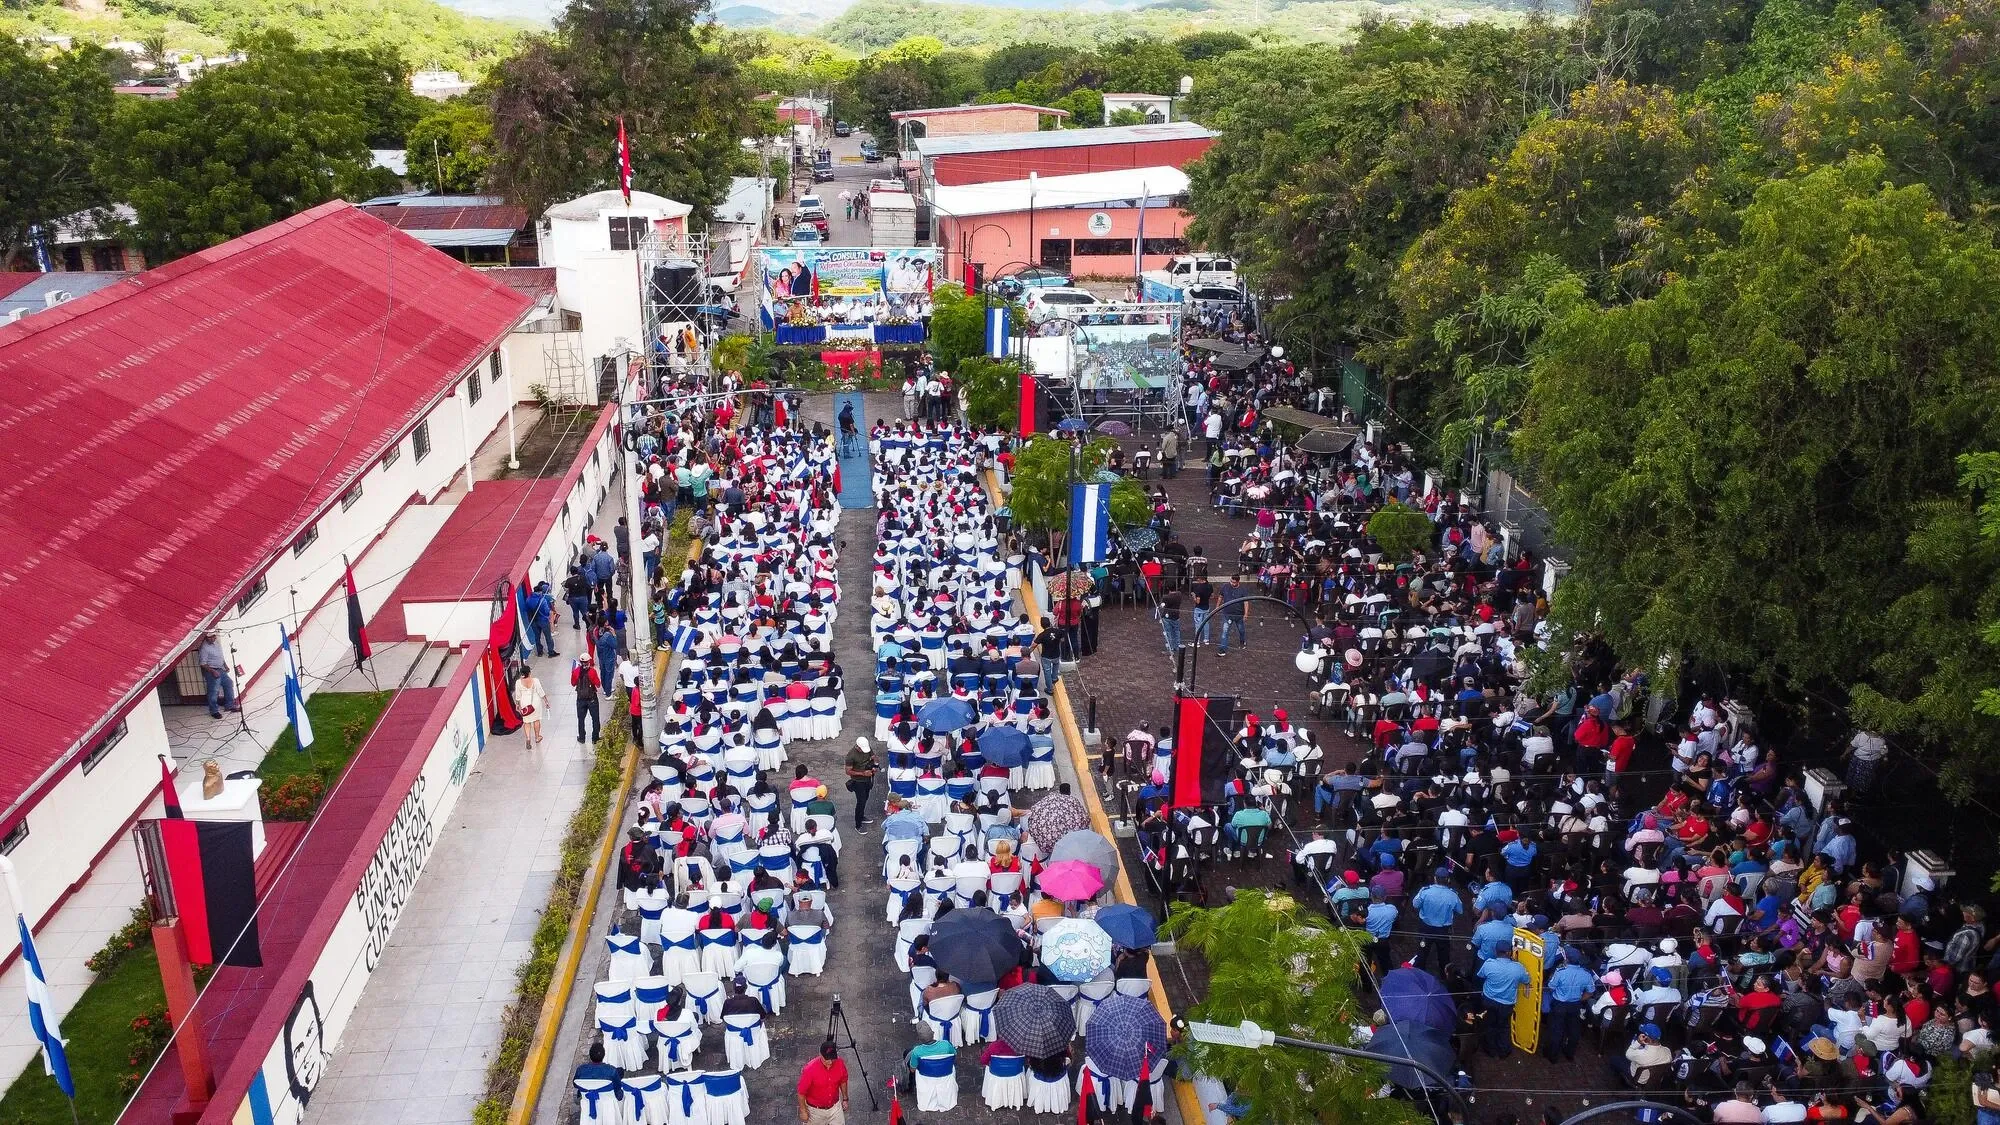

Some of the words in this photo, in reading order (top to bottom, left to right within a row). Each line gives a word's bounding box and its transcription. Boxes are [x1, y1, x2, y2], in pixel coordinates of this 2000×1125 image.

[820, 261, 843, 271] Reforma
[832, 251, 866, 261] CONSULTA
[356, 767, 426, 913] BIENVENIDOS
[365, 800, 427, 932] UNAN-LEON
[365, 821, 433, 974] CUR-SOMOTO
